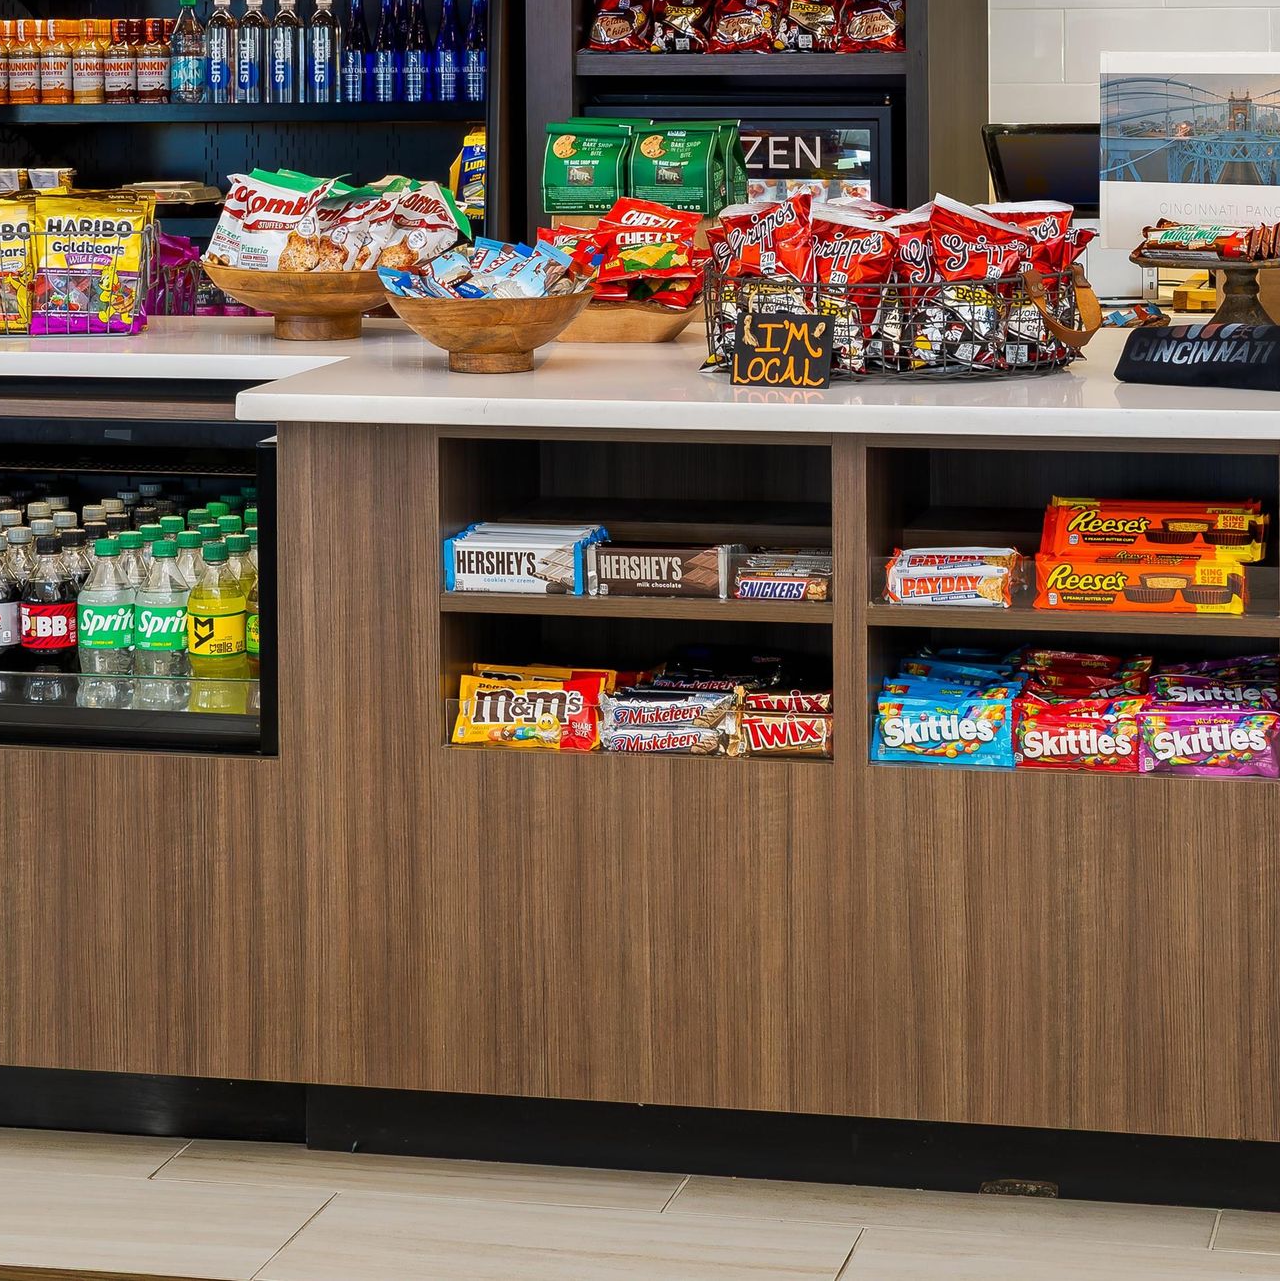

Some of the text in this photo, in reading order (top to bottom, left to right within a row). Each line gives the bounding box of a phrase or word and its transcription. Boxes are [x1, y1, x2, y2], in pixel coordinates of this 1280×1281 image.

[210, 38, 221, 82] smart
[211, 39, 220, 82] smart
[239, 38, 248, 83] smart
[275, 38, 285, 83] smart
[315, 38, 325, 83] smart
[740, 136, 821, 169] ZEN
[1160, 203, 1240, 216] CINCINNATI
[48, 219, 131, 238] HARIBO
[52, 242, 125, 255] Goldbears
[761, 253, 774, 263] 210
[833, 274, 846, 283] 210
[989, 269, 1000, 277] 210
[755, 320, 822, 357] I'M
[1130, 339, 1276, 364] CINCINNATI
[733, 354, 824, 386] LOCAL
[1068, 510, 1150, 533] Reese's
[1223, 521, 1245, 529] SIZE
[456, 551, 536, 575] HERSHEY'S
[600, 555, 682, 580] HERSHEY'S
[738, 581, 807, 599] SNICKERS
[903, 576, 984, 595] PAYDAY
[1048, 565, 1127, 591] Reese's
[1200, 576, 1223, 584] SIZE
[139, 610, 187, 636] Sprit
[473, 691, 584, 725] m&m's
[629, 706, 703, 725] Musketeers
[572, 721, 593, 731] SHARE
[744, 712, 826, 748] Twix
[884, 714, 994, 747] Skittles
[626, 733, 700, 751] Musketeers
[1024, 730, 1132, 759] Skittles
[1154, 725, 1266, 761] Skittles
